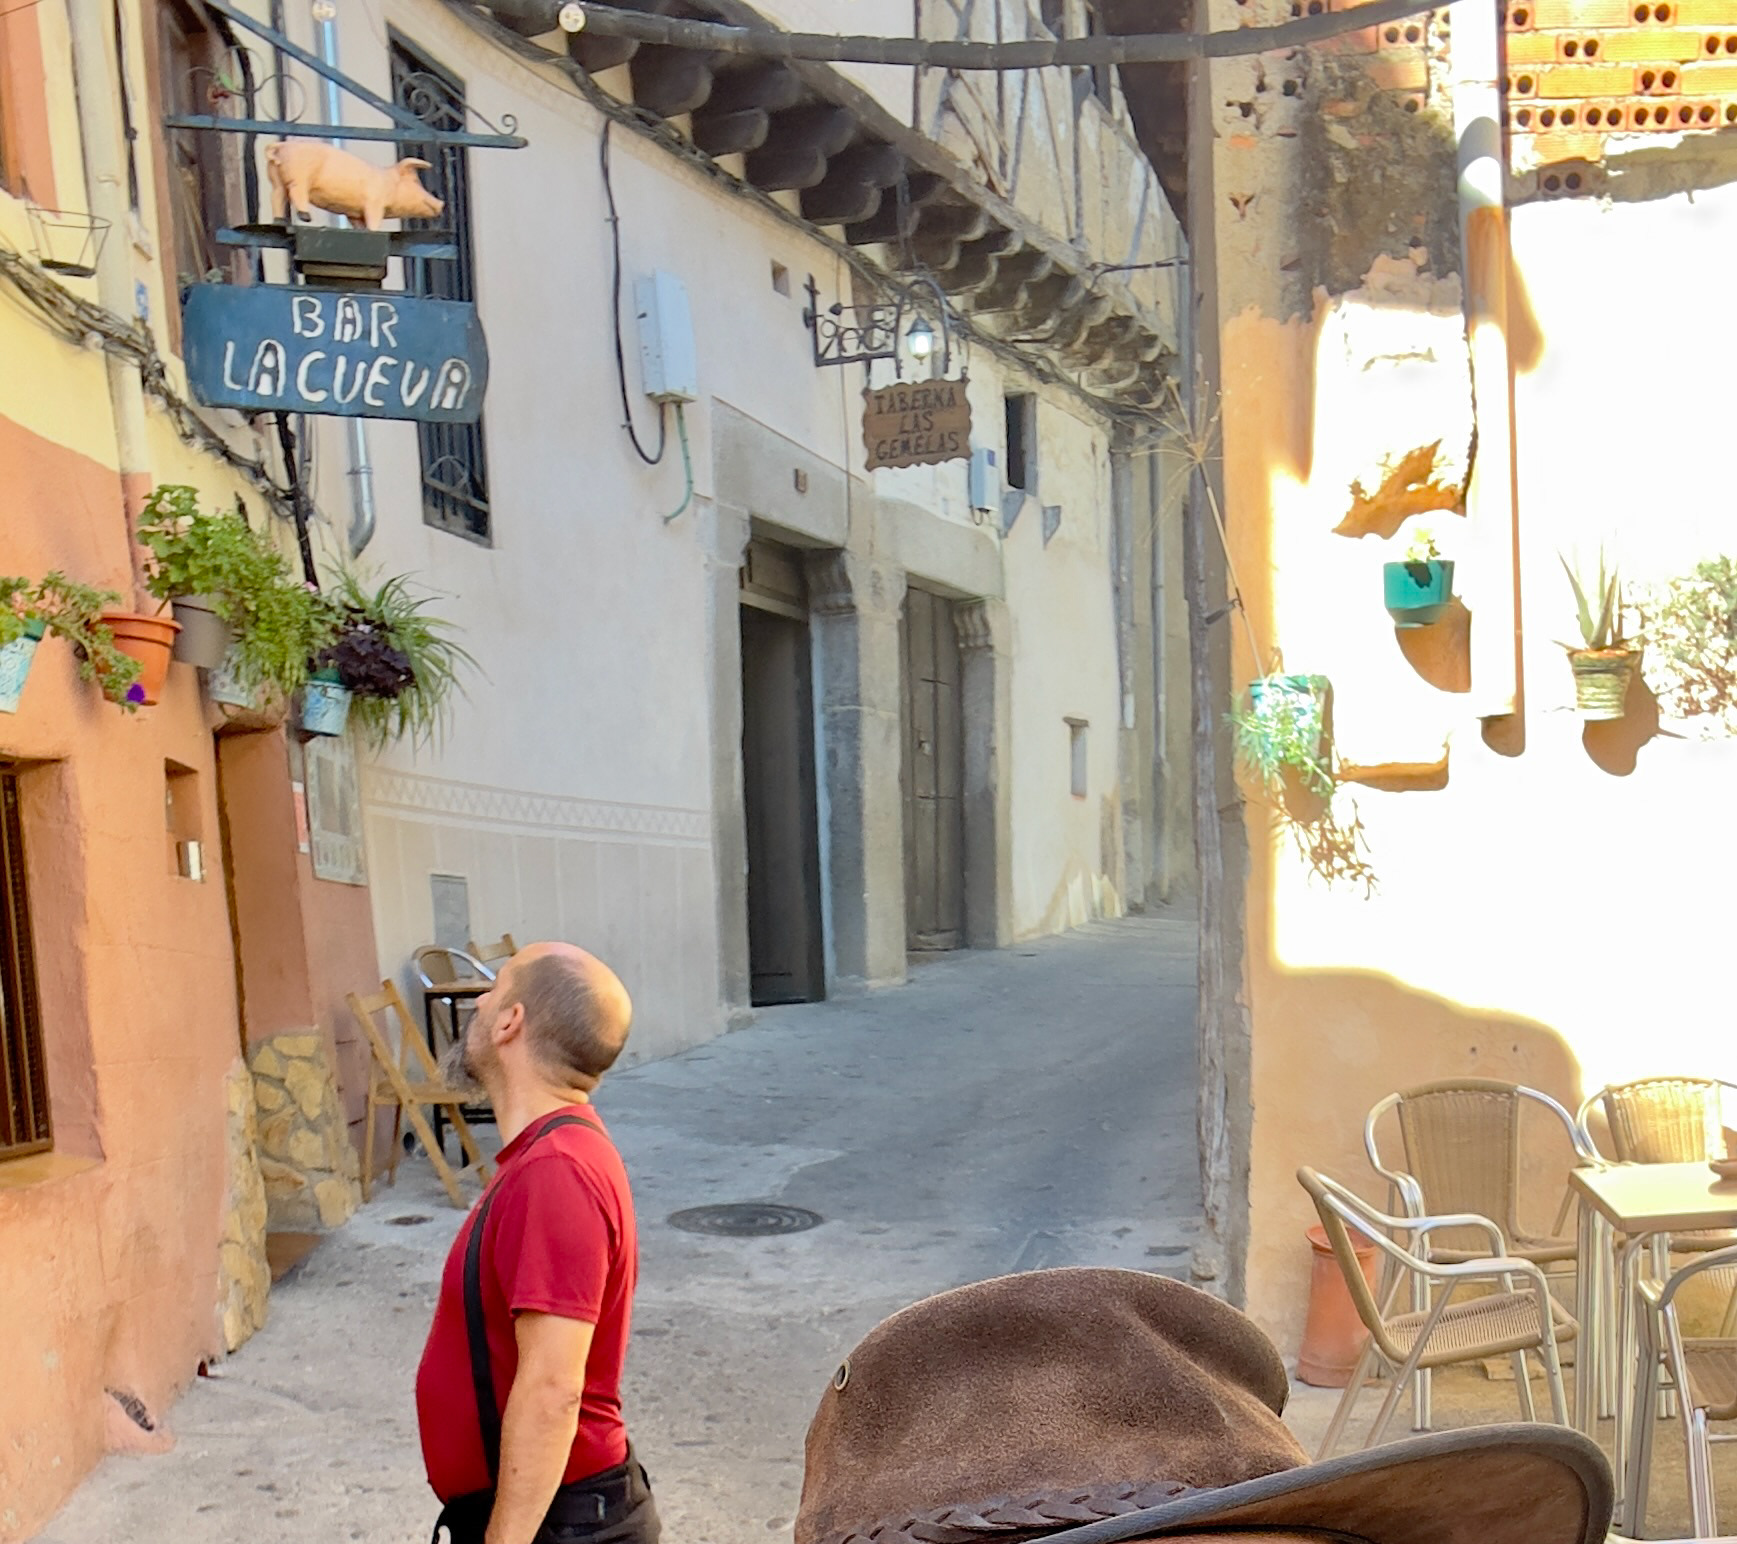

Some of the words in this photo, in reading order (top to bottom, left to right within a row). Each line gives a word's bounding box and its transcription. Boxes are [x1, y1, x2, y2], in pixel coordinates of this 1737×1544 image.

[291, 294, 398, 348] BAR
[874, 386, 957, 415] TABERNA
[899, 410, 934, 434] LAS
[875, 431, 959, 460] GEMELAS
